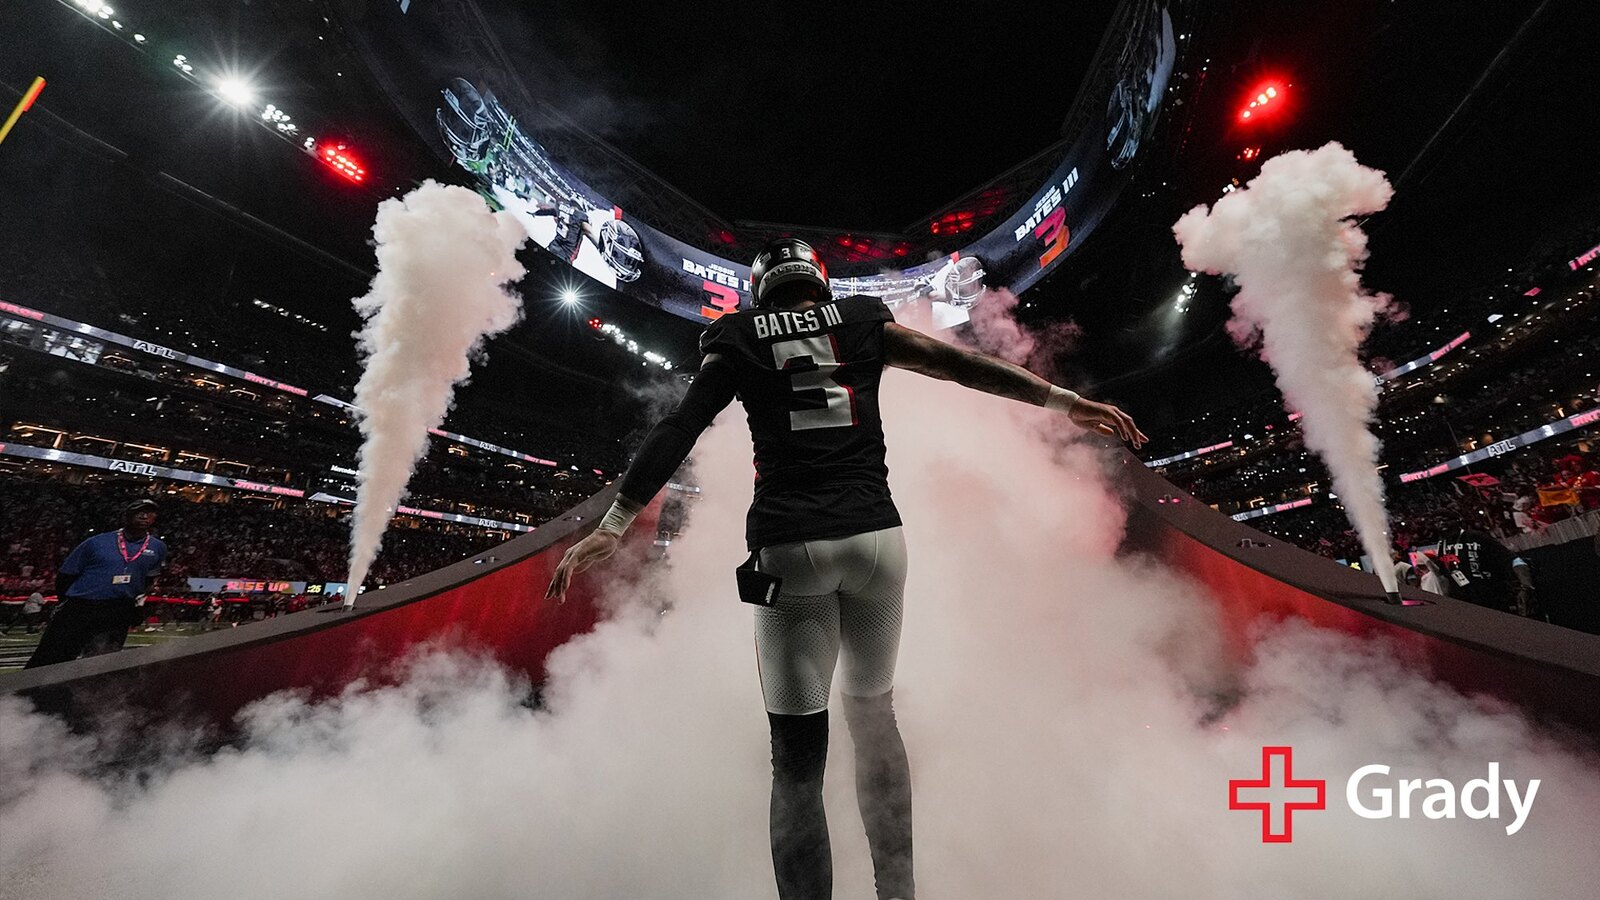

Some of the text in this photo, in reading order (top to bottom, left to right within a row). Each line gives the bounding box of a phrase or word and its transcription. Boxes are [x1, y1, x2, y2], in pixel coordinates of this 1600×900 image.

[1014, 166, 1079, 242] BATES III
[1034, 206, 1070, 268] 3
[782, 247, 791, 259] 3
[682, 258, 740, 289] BATES
[701, 280, 740, 320] 3
[753, 303, 843, 339] BATES III
[132, 339, 176, 360] ATL
[772, 333, 859, 431] 3
[1486, 439, 1517, 457] ATL
[109, 459, 157, 477] ATL
[225, 581, 290, 592] RISE UP
